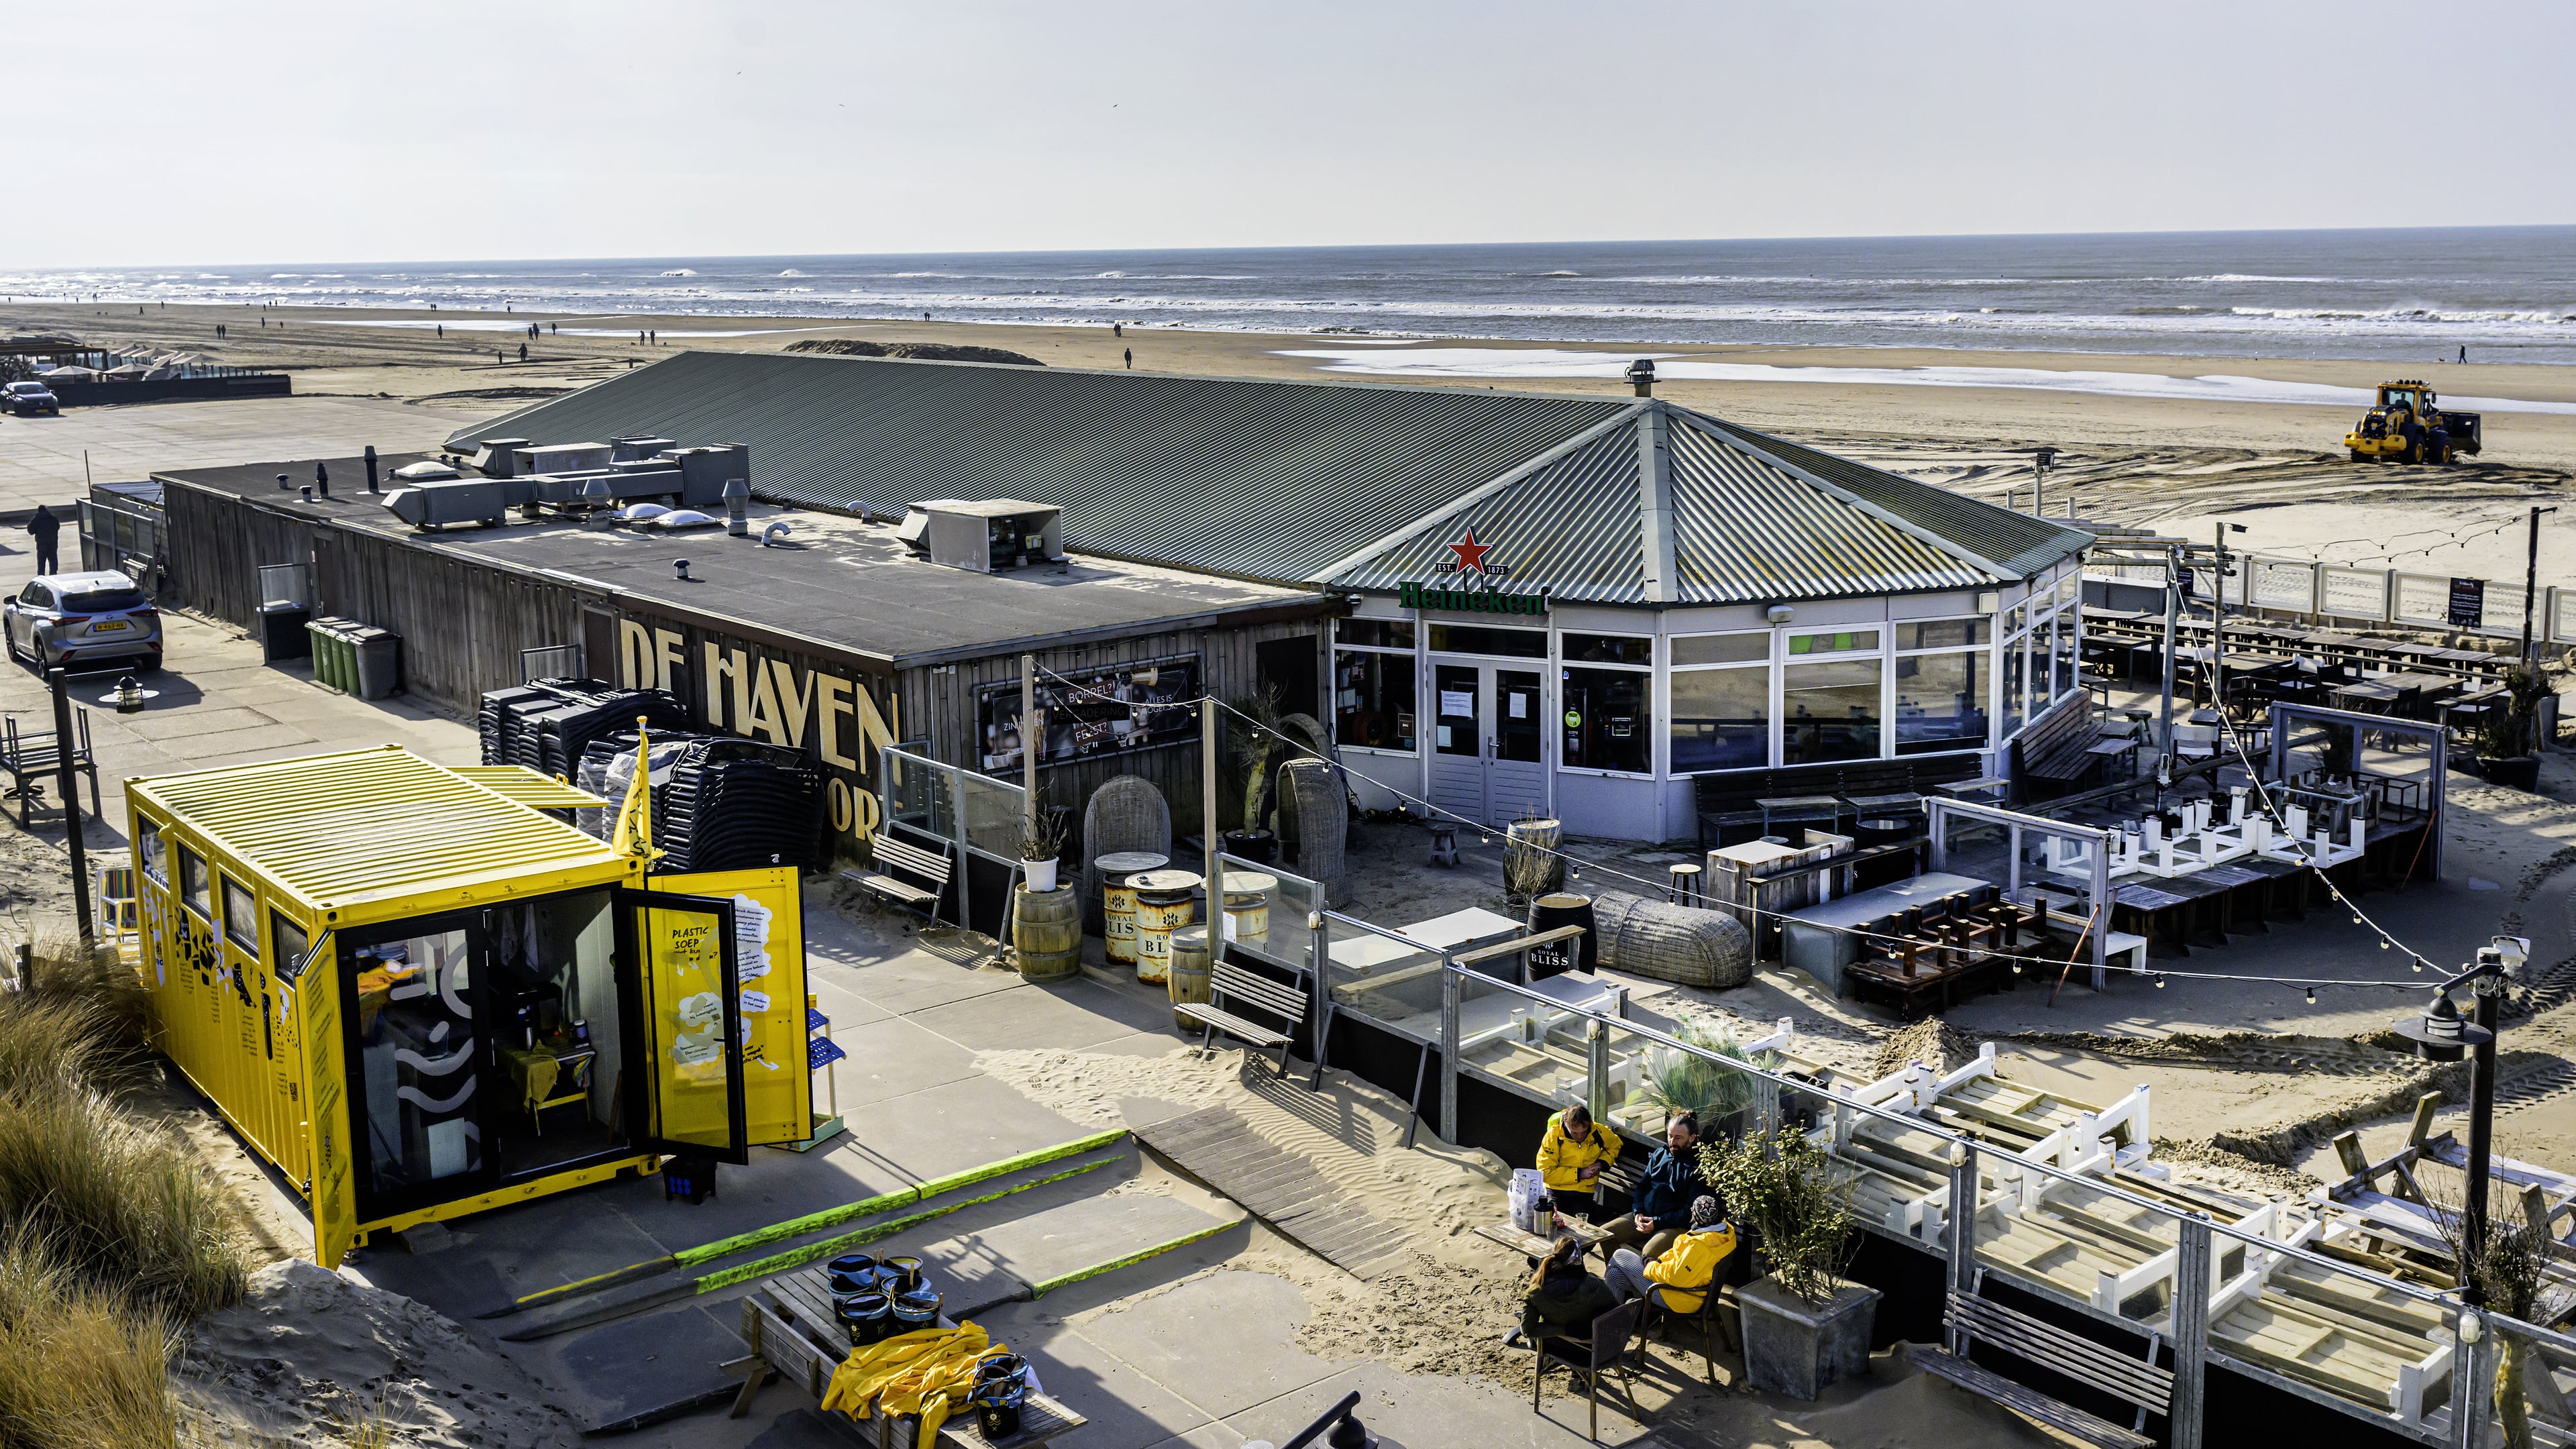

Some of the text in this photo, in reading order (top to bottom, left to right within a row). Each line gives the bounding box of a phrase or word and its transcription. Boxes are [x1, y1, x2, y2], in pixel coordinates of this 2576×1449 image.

[1488, 566, 1505, 574] 1873
[1399, 580, 1548, 616] Heineken
[1068, 682, 1113, 703] BORREL?
[1166, 694, 1173, 702] IS
[621, 619, 902, 787] DE HAVEN
[1108, 914, 1134, 922] ROYAL
[672, 926, 709, 938] PLASTIC
[675, 938, 699, 949] SOEP
[1531, 953, 1568, 966] BLISS
